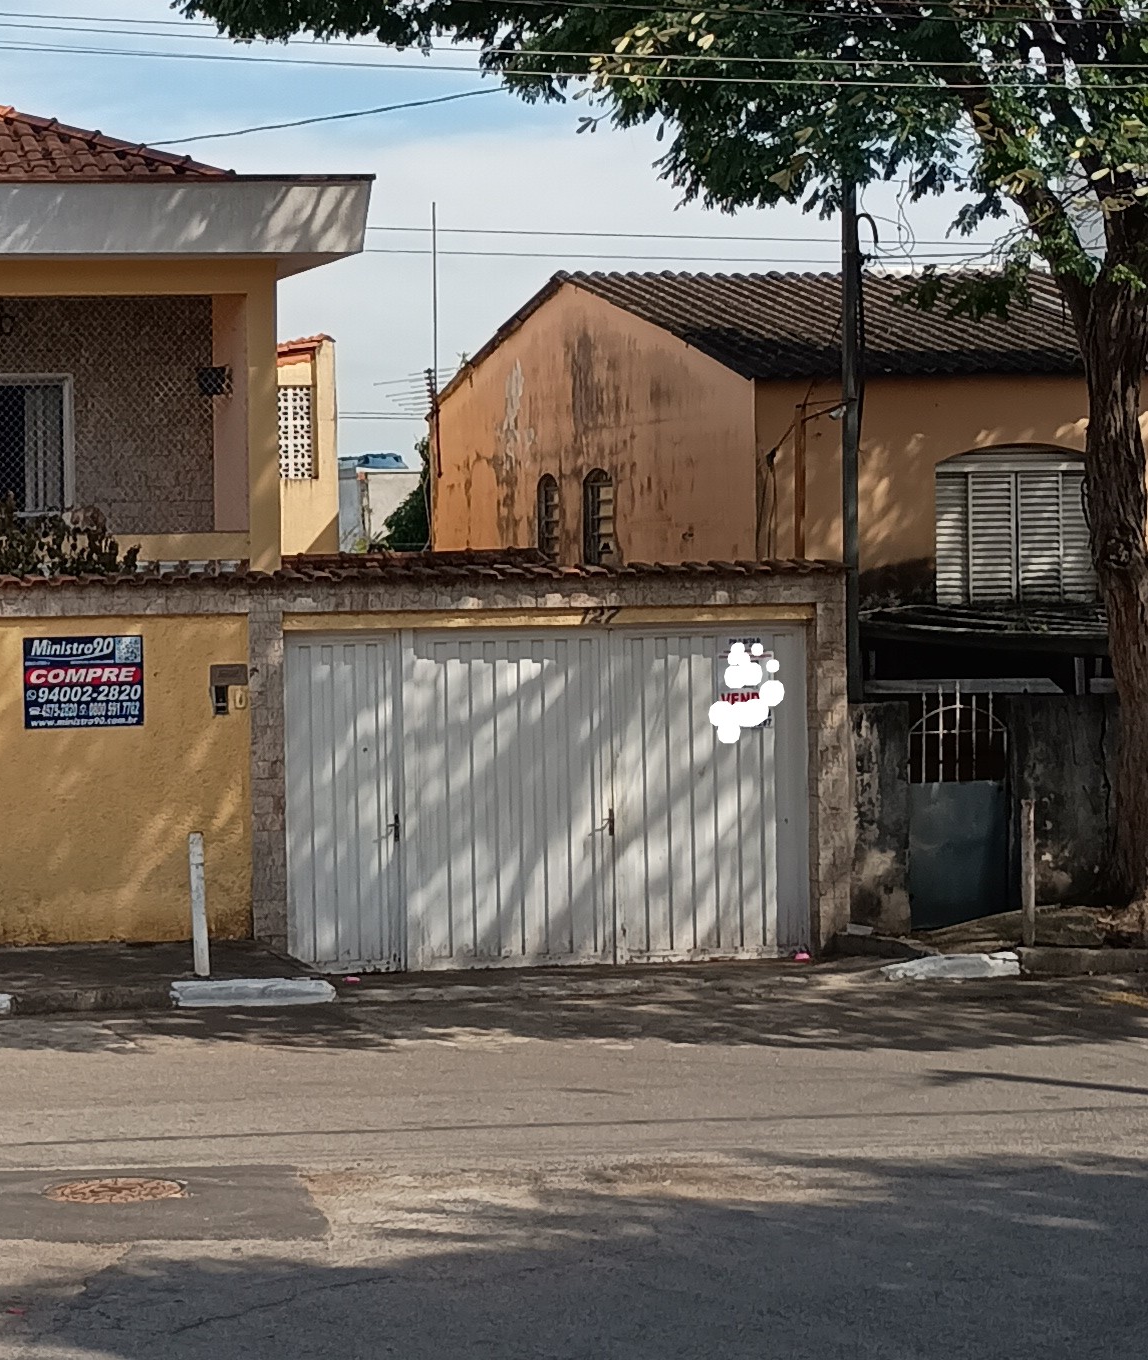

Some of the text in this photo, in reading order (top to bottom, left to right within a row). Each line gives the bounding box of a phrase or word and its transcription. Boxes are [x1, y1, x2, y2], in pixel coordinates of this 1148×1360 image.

[30, 667, 136, 684] COMPRE
[38, 685, 141, 703] 94002-2820
[31, 716, 138, 727] www.ministro90.com.br
